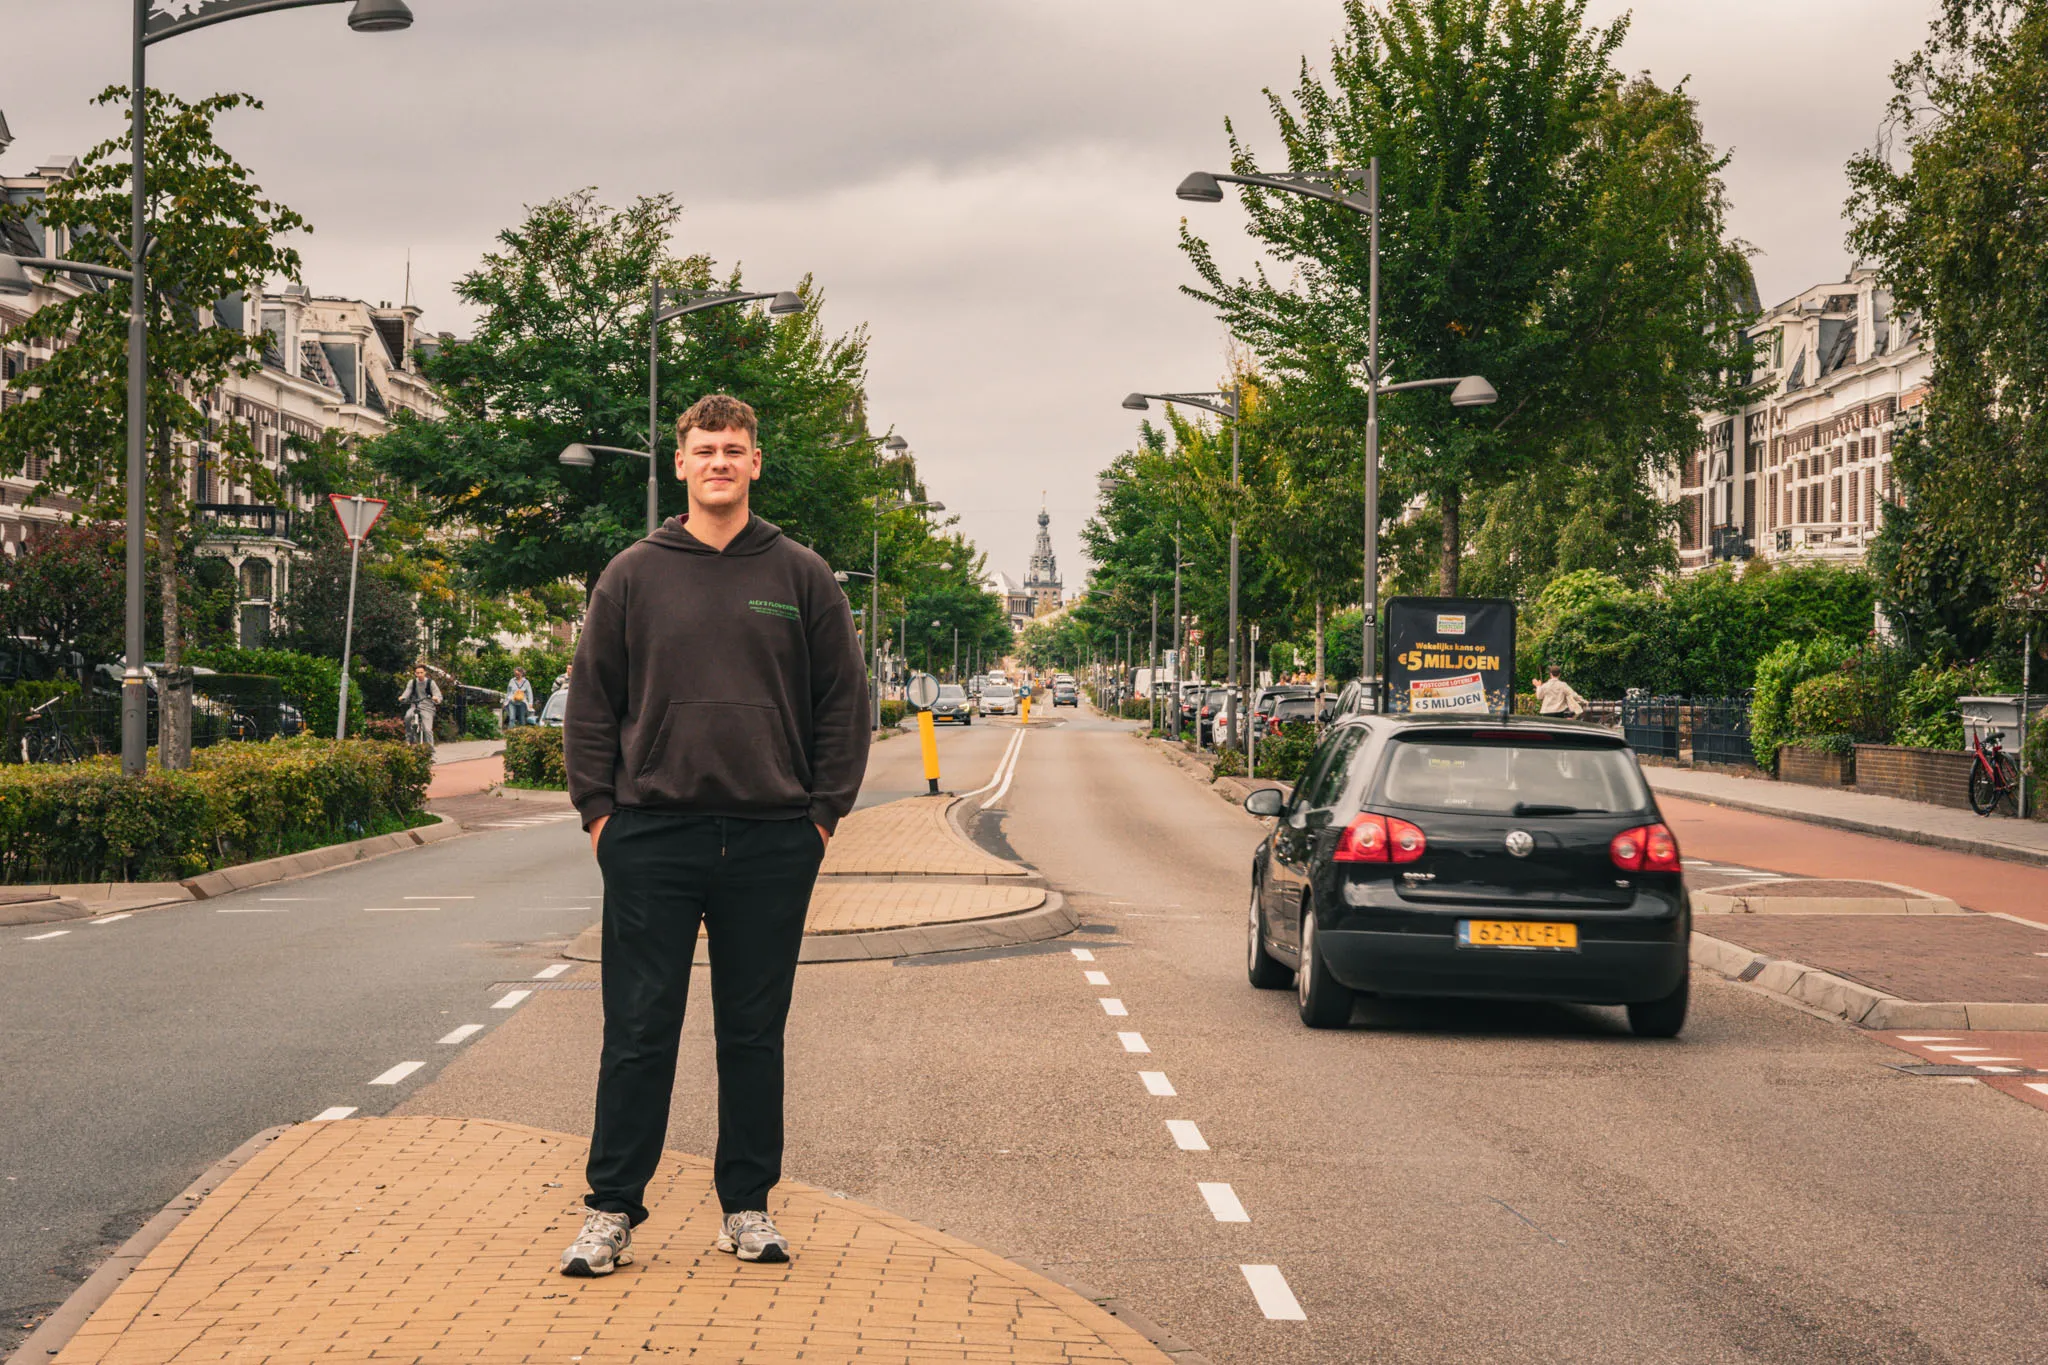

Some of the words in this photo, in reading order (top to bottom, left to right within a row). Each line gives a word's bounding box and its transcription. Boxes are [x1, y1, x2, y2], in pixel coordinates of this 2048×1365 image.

[1415, 642, 1453, 652] Wekelijks
[1455, 643, 1473, 651] kans
[1474, 645, 1486, 653] op
[1424, 654, 1499, 670] MILJOEN
[1431, 692, 1481, 709] MILJOEN
[1479, 923, 1566, 944] 62-XL-FL
